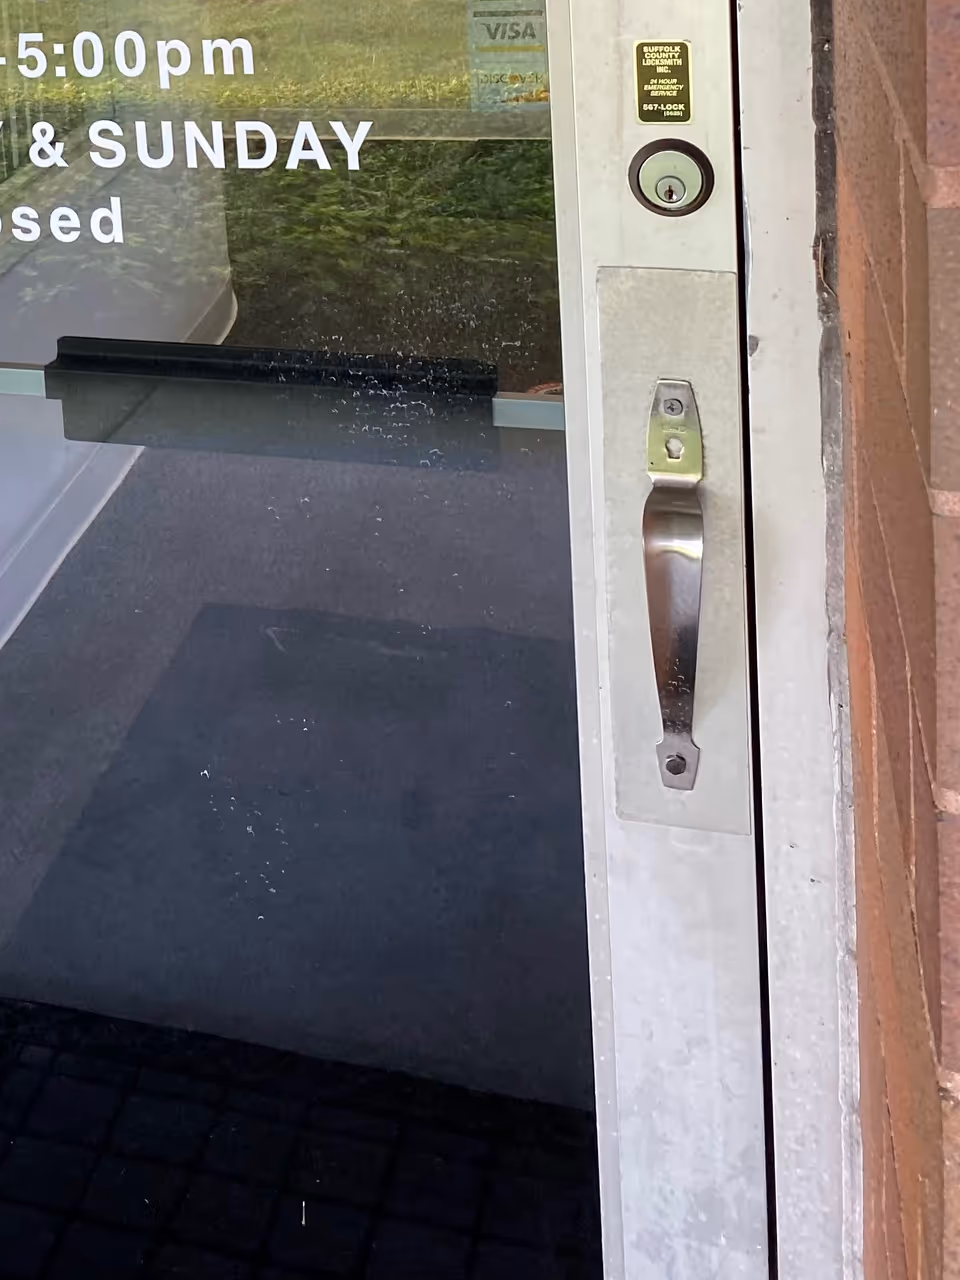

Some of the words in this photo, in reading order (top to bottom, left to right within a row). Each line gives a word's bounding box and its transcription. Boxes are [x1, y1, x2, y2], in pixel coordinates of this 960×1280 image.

[481, 22, 537, 40] VISA
[642, 58, 683, 66] LOCKSMITH
[29, 120, 69, 168] &
[89, 119, 374, 171] SUNDAY
